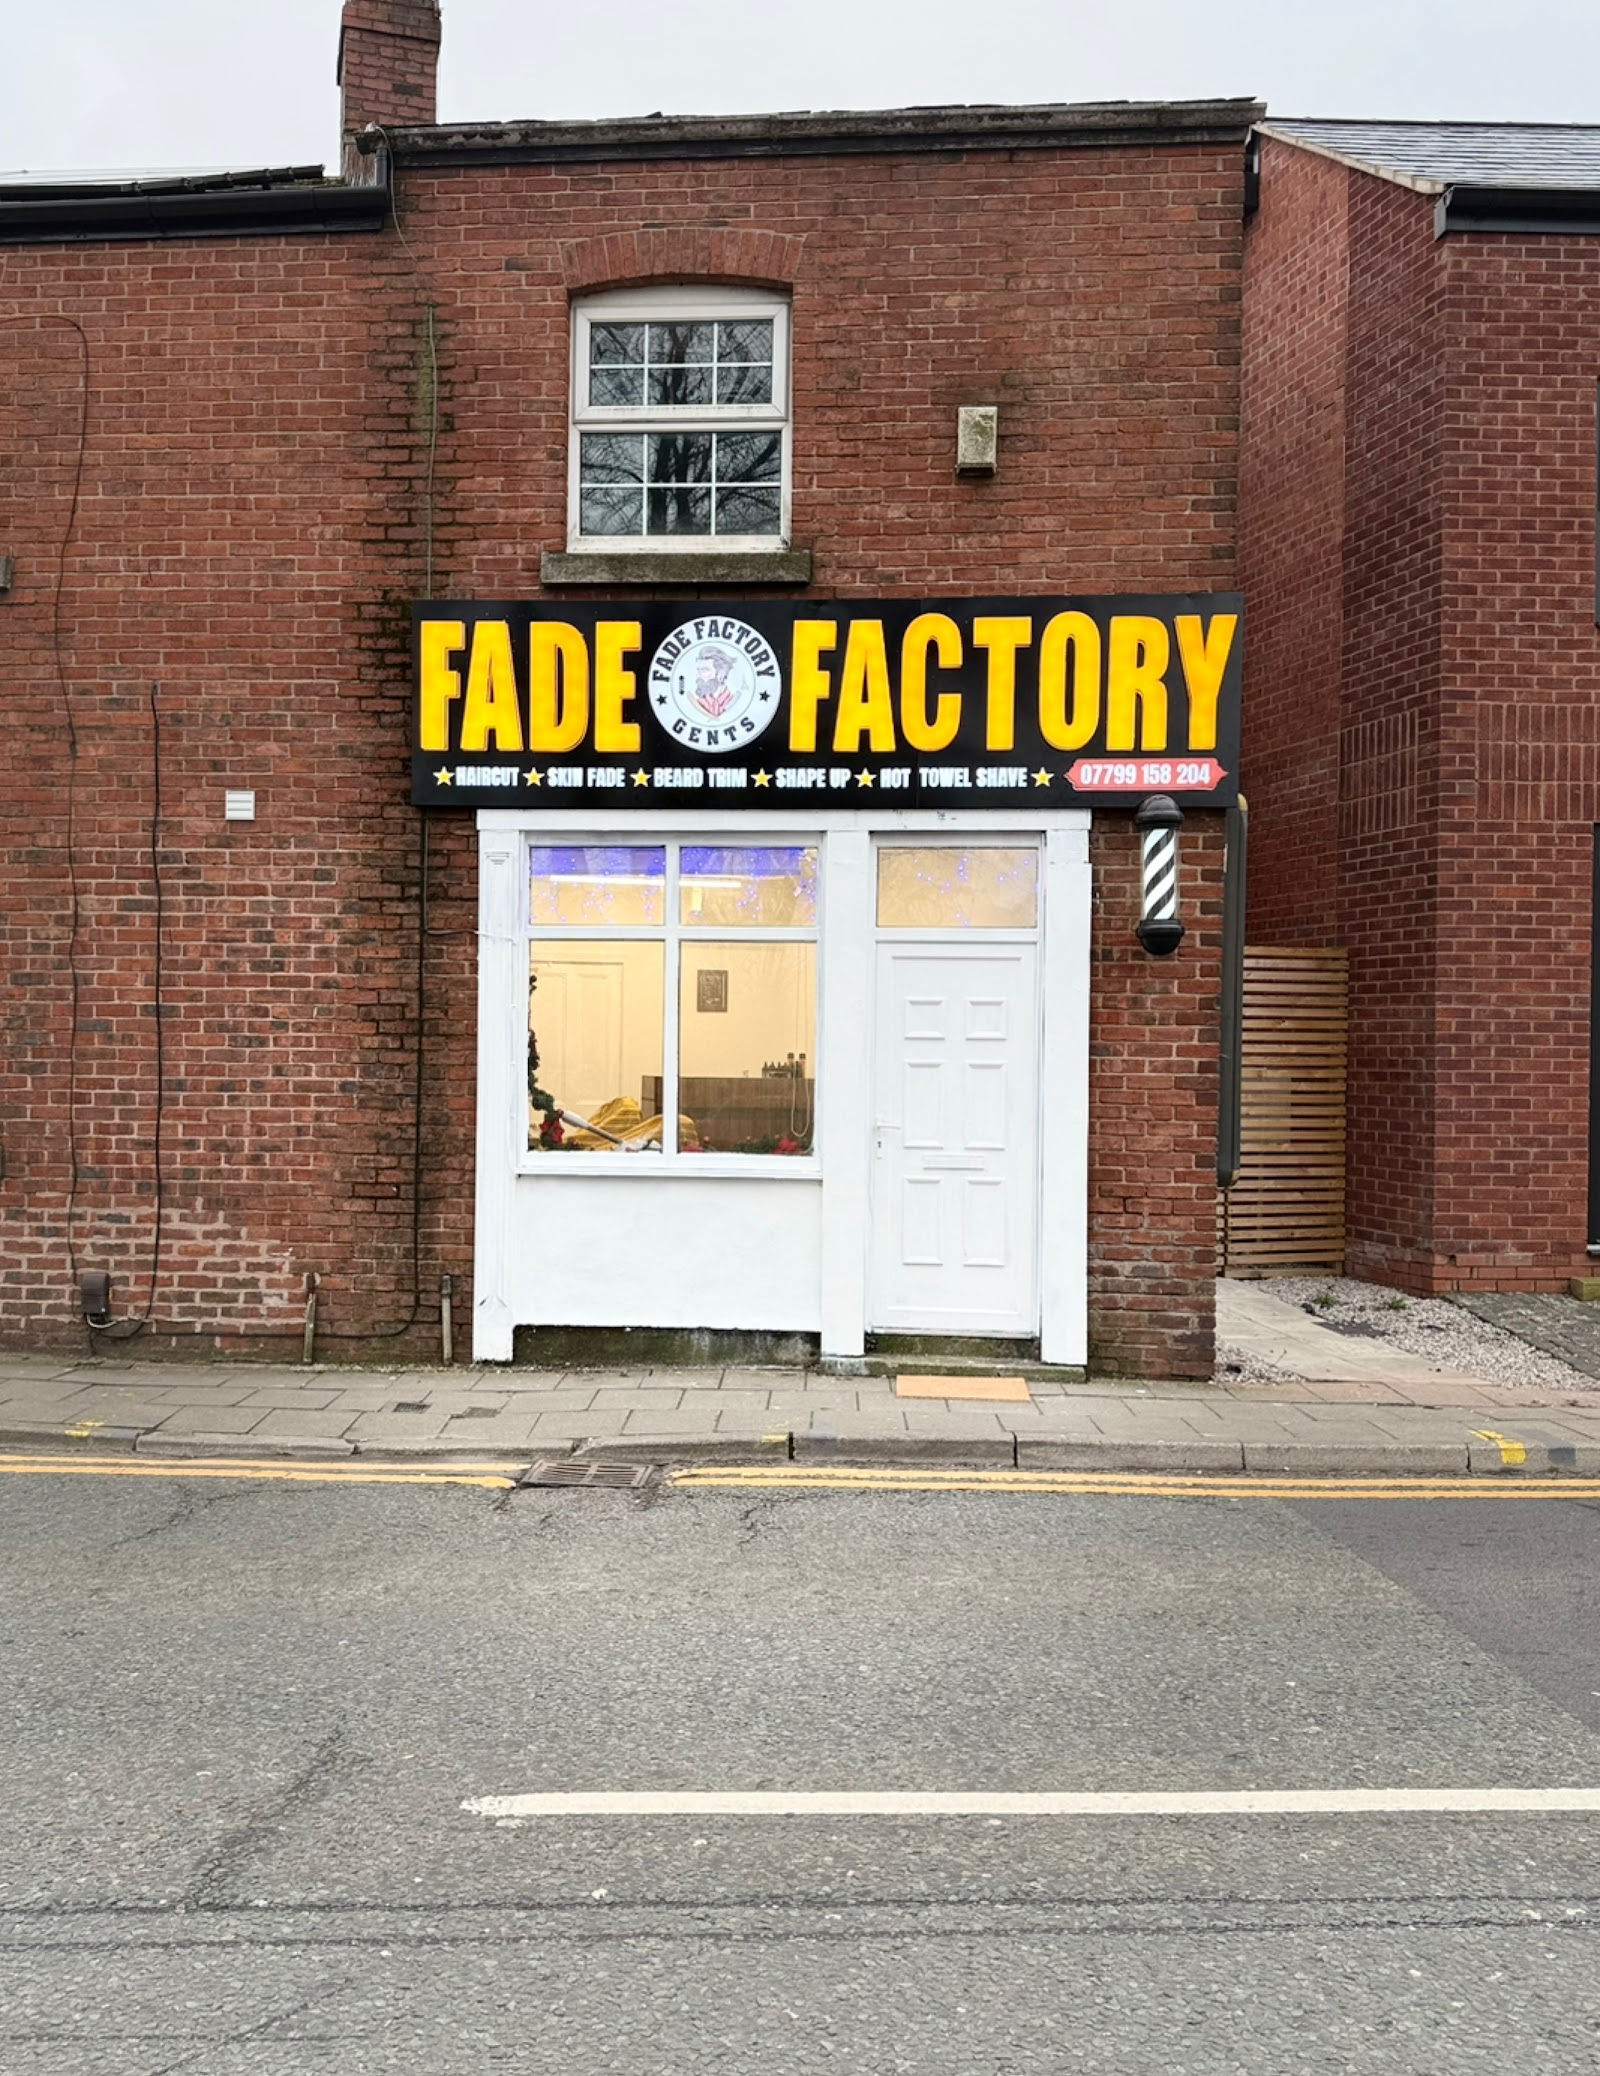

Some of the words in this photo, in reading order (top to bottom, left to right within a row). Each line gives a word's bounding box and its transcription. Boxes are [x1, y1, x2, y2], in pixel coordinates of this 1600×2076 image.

[652, 629, 692, 682] FADE
[693, 619, 775, 678] FACTORY
[420, 620, 642, 752] FADE
[788, 611, 1238, 752] FACTORY
[672, 717, 755, 745] GENTS
[455, 766, 520, 787] HAIRCUT
[547, 767, 584, 788] SKIN
[587, 767, 626, 788] FADE
[653, 767, 704, 788] BEARD
[707, 767, 748, 788] TRIM
[775, 767, 826, 788] SHAPE
[829, 767, 851, 788] UP
[880, 768, 912, 788] HOT
[919, 767, 972, 788] TOWEL
[976, 767, 1028, 788] SHAVE
[1080, 764, 1136, 785] 07799
[1140, 763, 1172, 785] 158
[1175, 763, 1211, 784] 204
